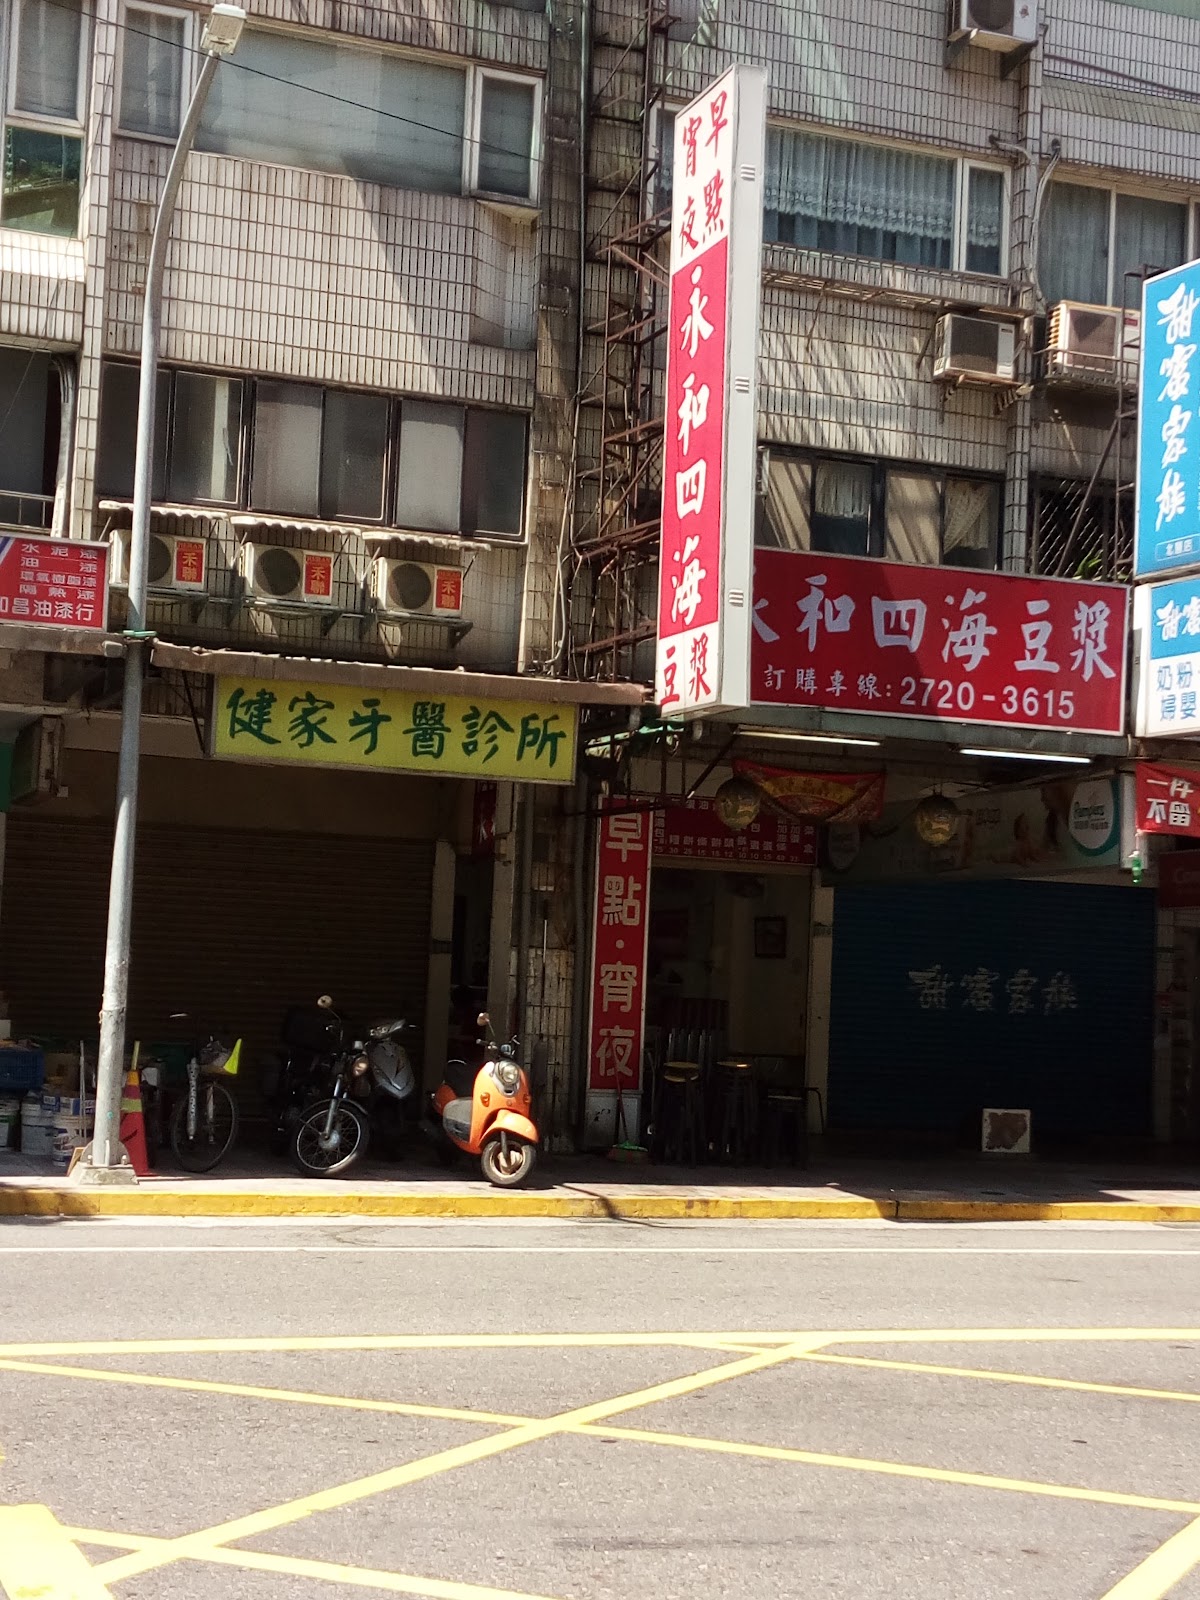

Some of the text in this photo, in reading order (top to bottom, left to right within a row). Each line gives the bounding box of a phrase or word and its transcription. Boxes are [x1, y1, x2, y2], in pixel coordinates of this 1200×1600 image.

[679, 115, 702, 258] 宵夜
[705, 90, 728, 244] 早點
[226, 686, 567, 768] 健家牙醫診所
[1146, 777, 1194, 799] 一件
[1146, 798, 1191, 827] 不留
